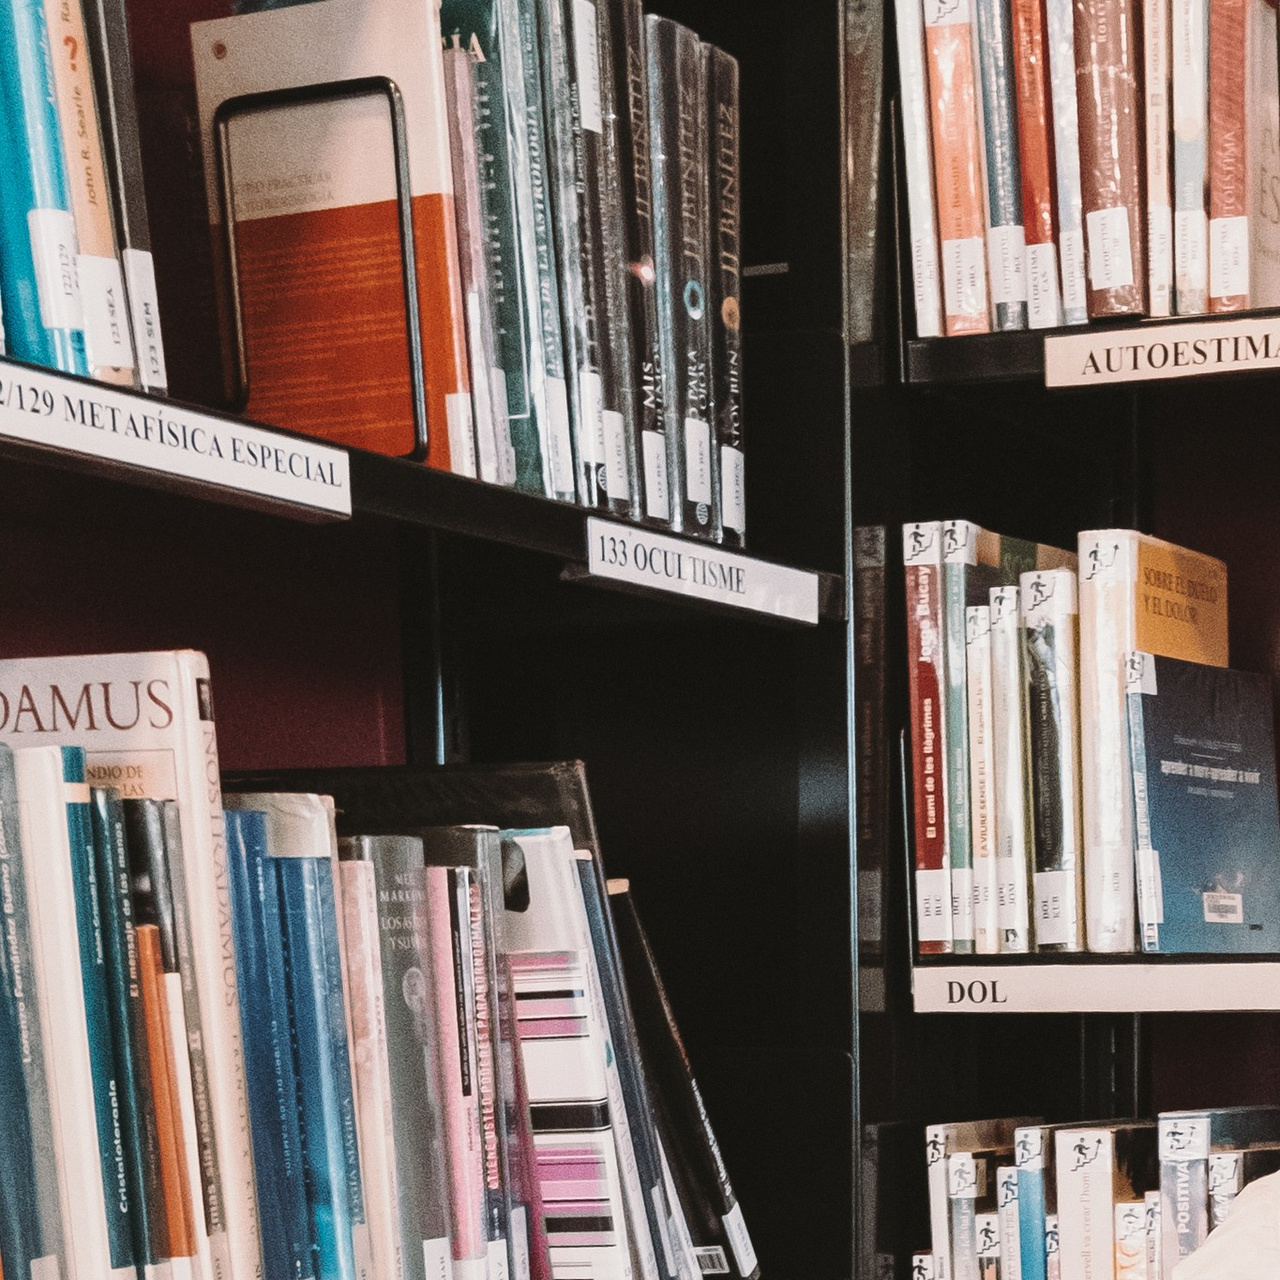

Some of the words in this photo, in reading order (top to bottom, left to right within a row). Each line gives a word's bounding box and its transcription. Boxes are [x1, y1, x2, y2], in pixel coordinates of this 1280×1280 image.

[0, 380, 55, 415] /129
[63, 395, 224, 460] METAFÍSICA
[230, 437, 342, 488] ESPECIAL
[599, 534, 629, 567] 133
[633, 542, 747, 595] OCULTISME
[916, 564, 931, 616] Bucay
[1143, 566, 1174, 592] SOBRE
[921, 776, 935, 792] de
[925, 826, 937, 839] El
[203, 729, 238, 1009] NOSTRADAMUS
[946, 979, 1008, 1005] DOL
[108, 1080, 128, 1214] Cristaloterapia
[1176, 1160, 1190, 1234] POSITIVA
